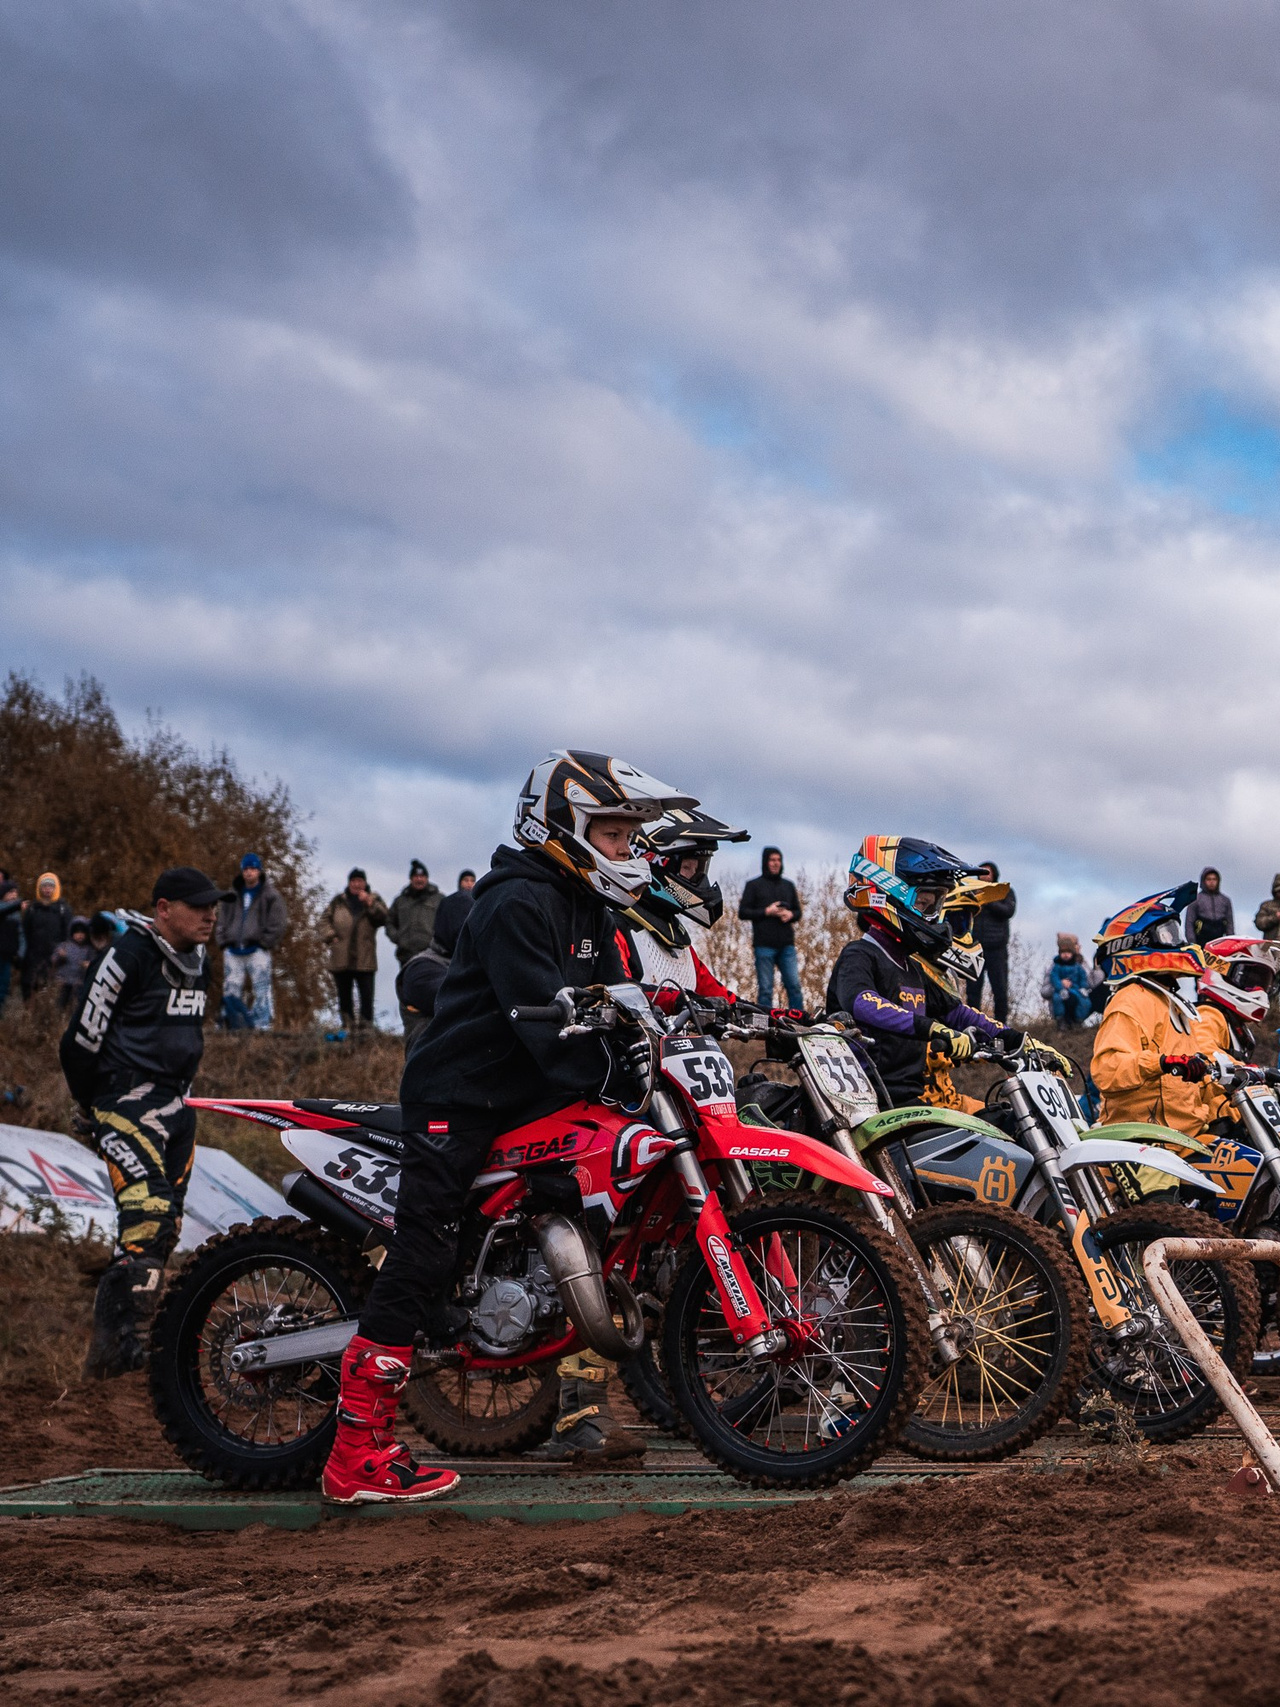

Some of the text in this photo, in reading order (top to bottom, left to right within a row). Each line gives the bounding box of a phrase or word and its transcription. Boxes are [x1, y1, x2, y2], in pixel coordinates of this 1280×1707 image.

[1106, 929, 1150, 955] 100%
[166, 988, 207, 1017] LEA
[487, 1131, 579, 1167] ASGAS
[728, 1146, 790, 1157] GASGAS
